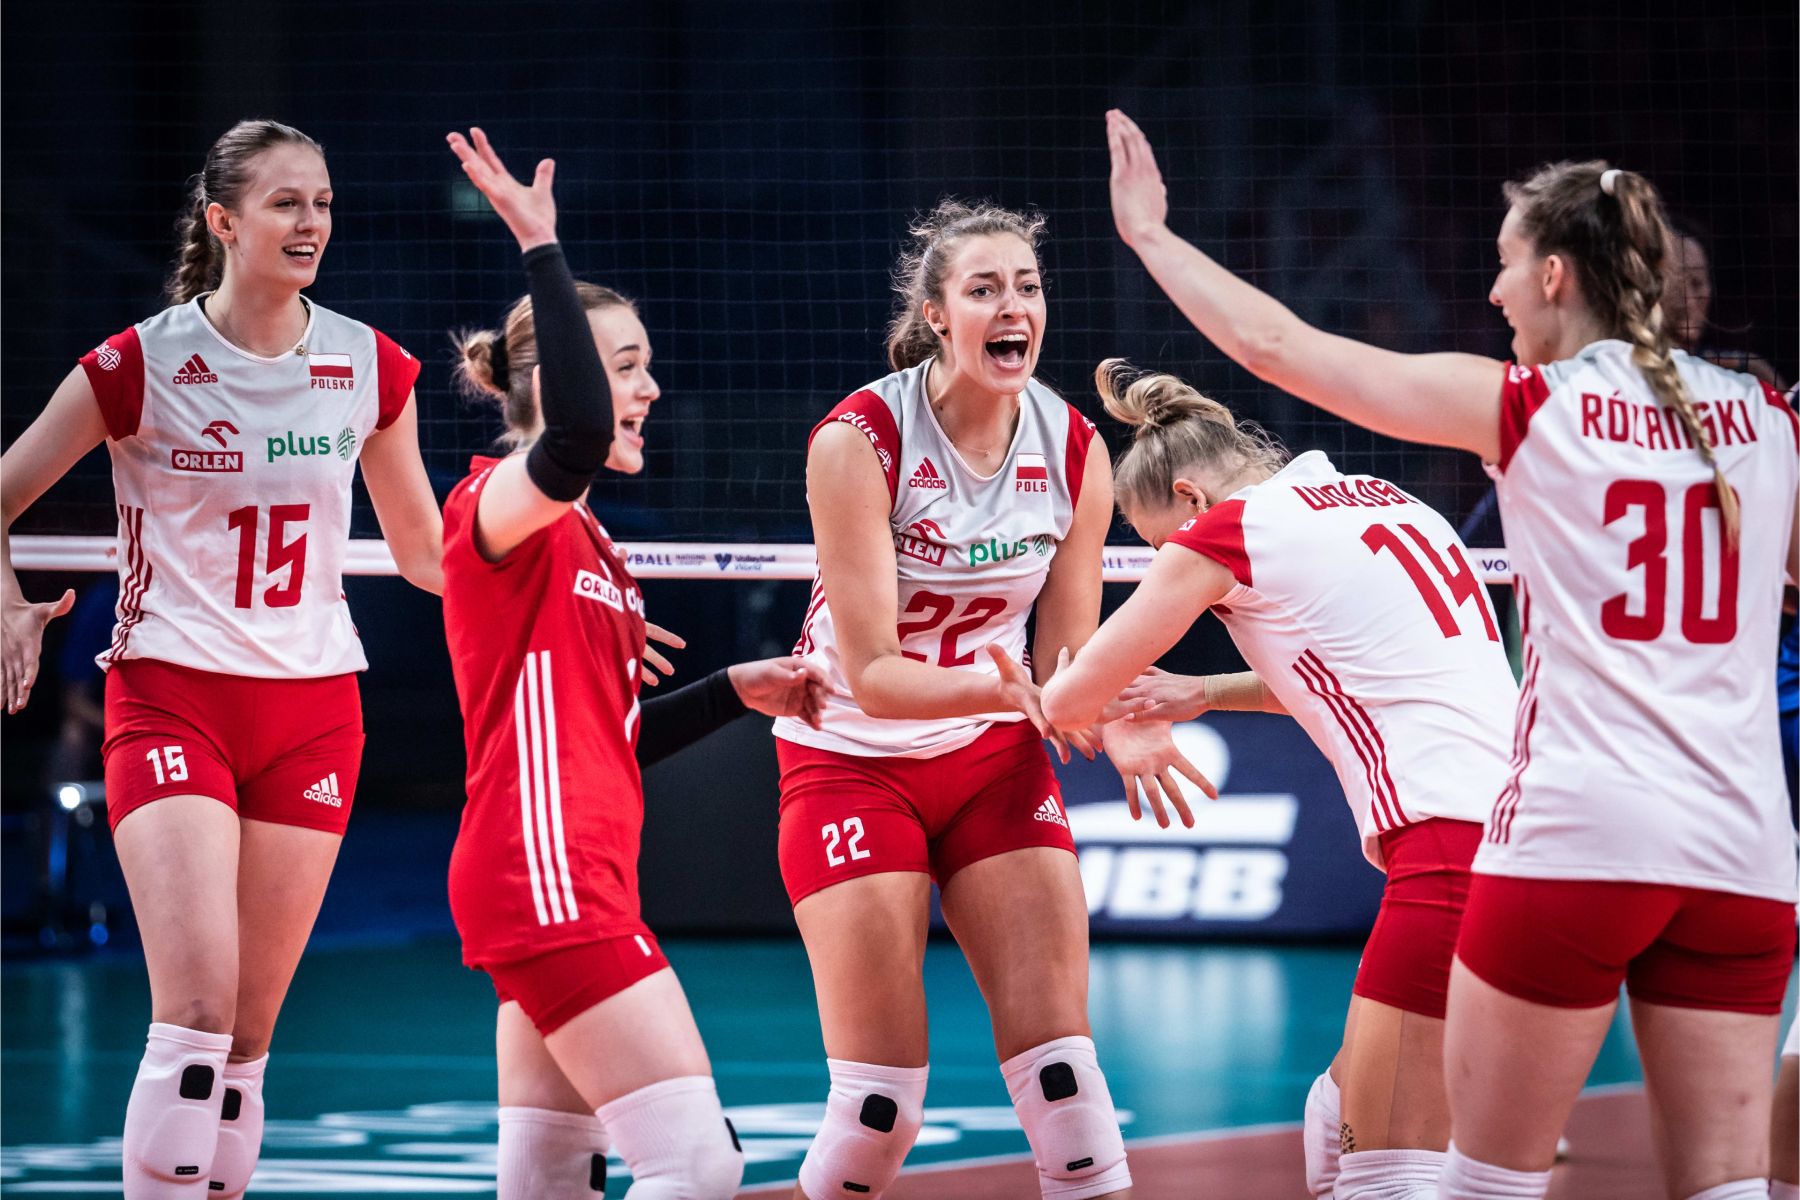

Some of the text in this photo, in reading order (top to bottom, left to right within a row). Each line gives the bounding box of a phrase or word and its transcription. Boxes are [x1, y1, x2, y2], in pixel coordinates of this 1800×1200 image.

[173, 372, 218, 385] adidas
[311, 378, 354, 391] POLSKA
[838, 411, 879, 444] plus
[174, 452, 239, 470] ORLEN
[267, 431, 330, 463] plus
[908, 476, 947, 489] adidas
[1016, 481, 1048, 493] POLS
[1291, 479, 1419, 511] WOŁOS
[228, 503, 311, 609] 15
[969, 536, 1029, 567] plus
[1601, 479, 1741, 644] 30
[1360, 523, 1500, 642] 14
[897, 590, 1008, 668] 22
[146, 745, 189, 785] 15
[303, 788, 343, 808] adidas
[821, 816, 871, 868] 22
